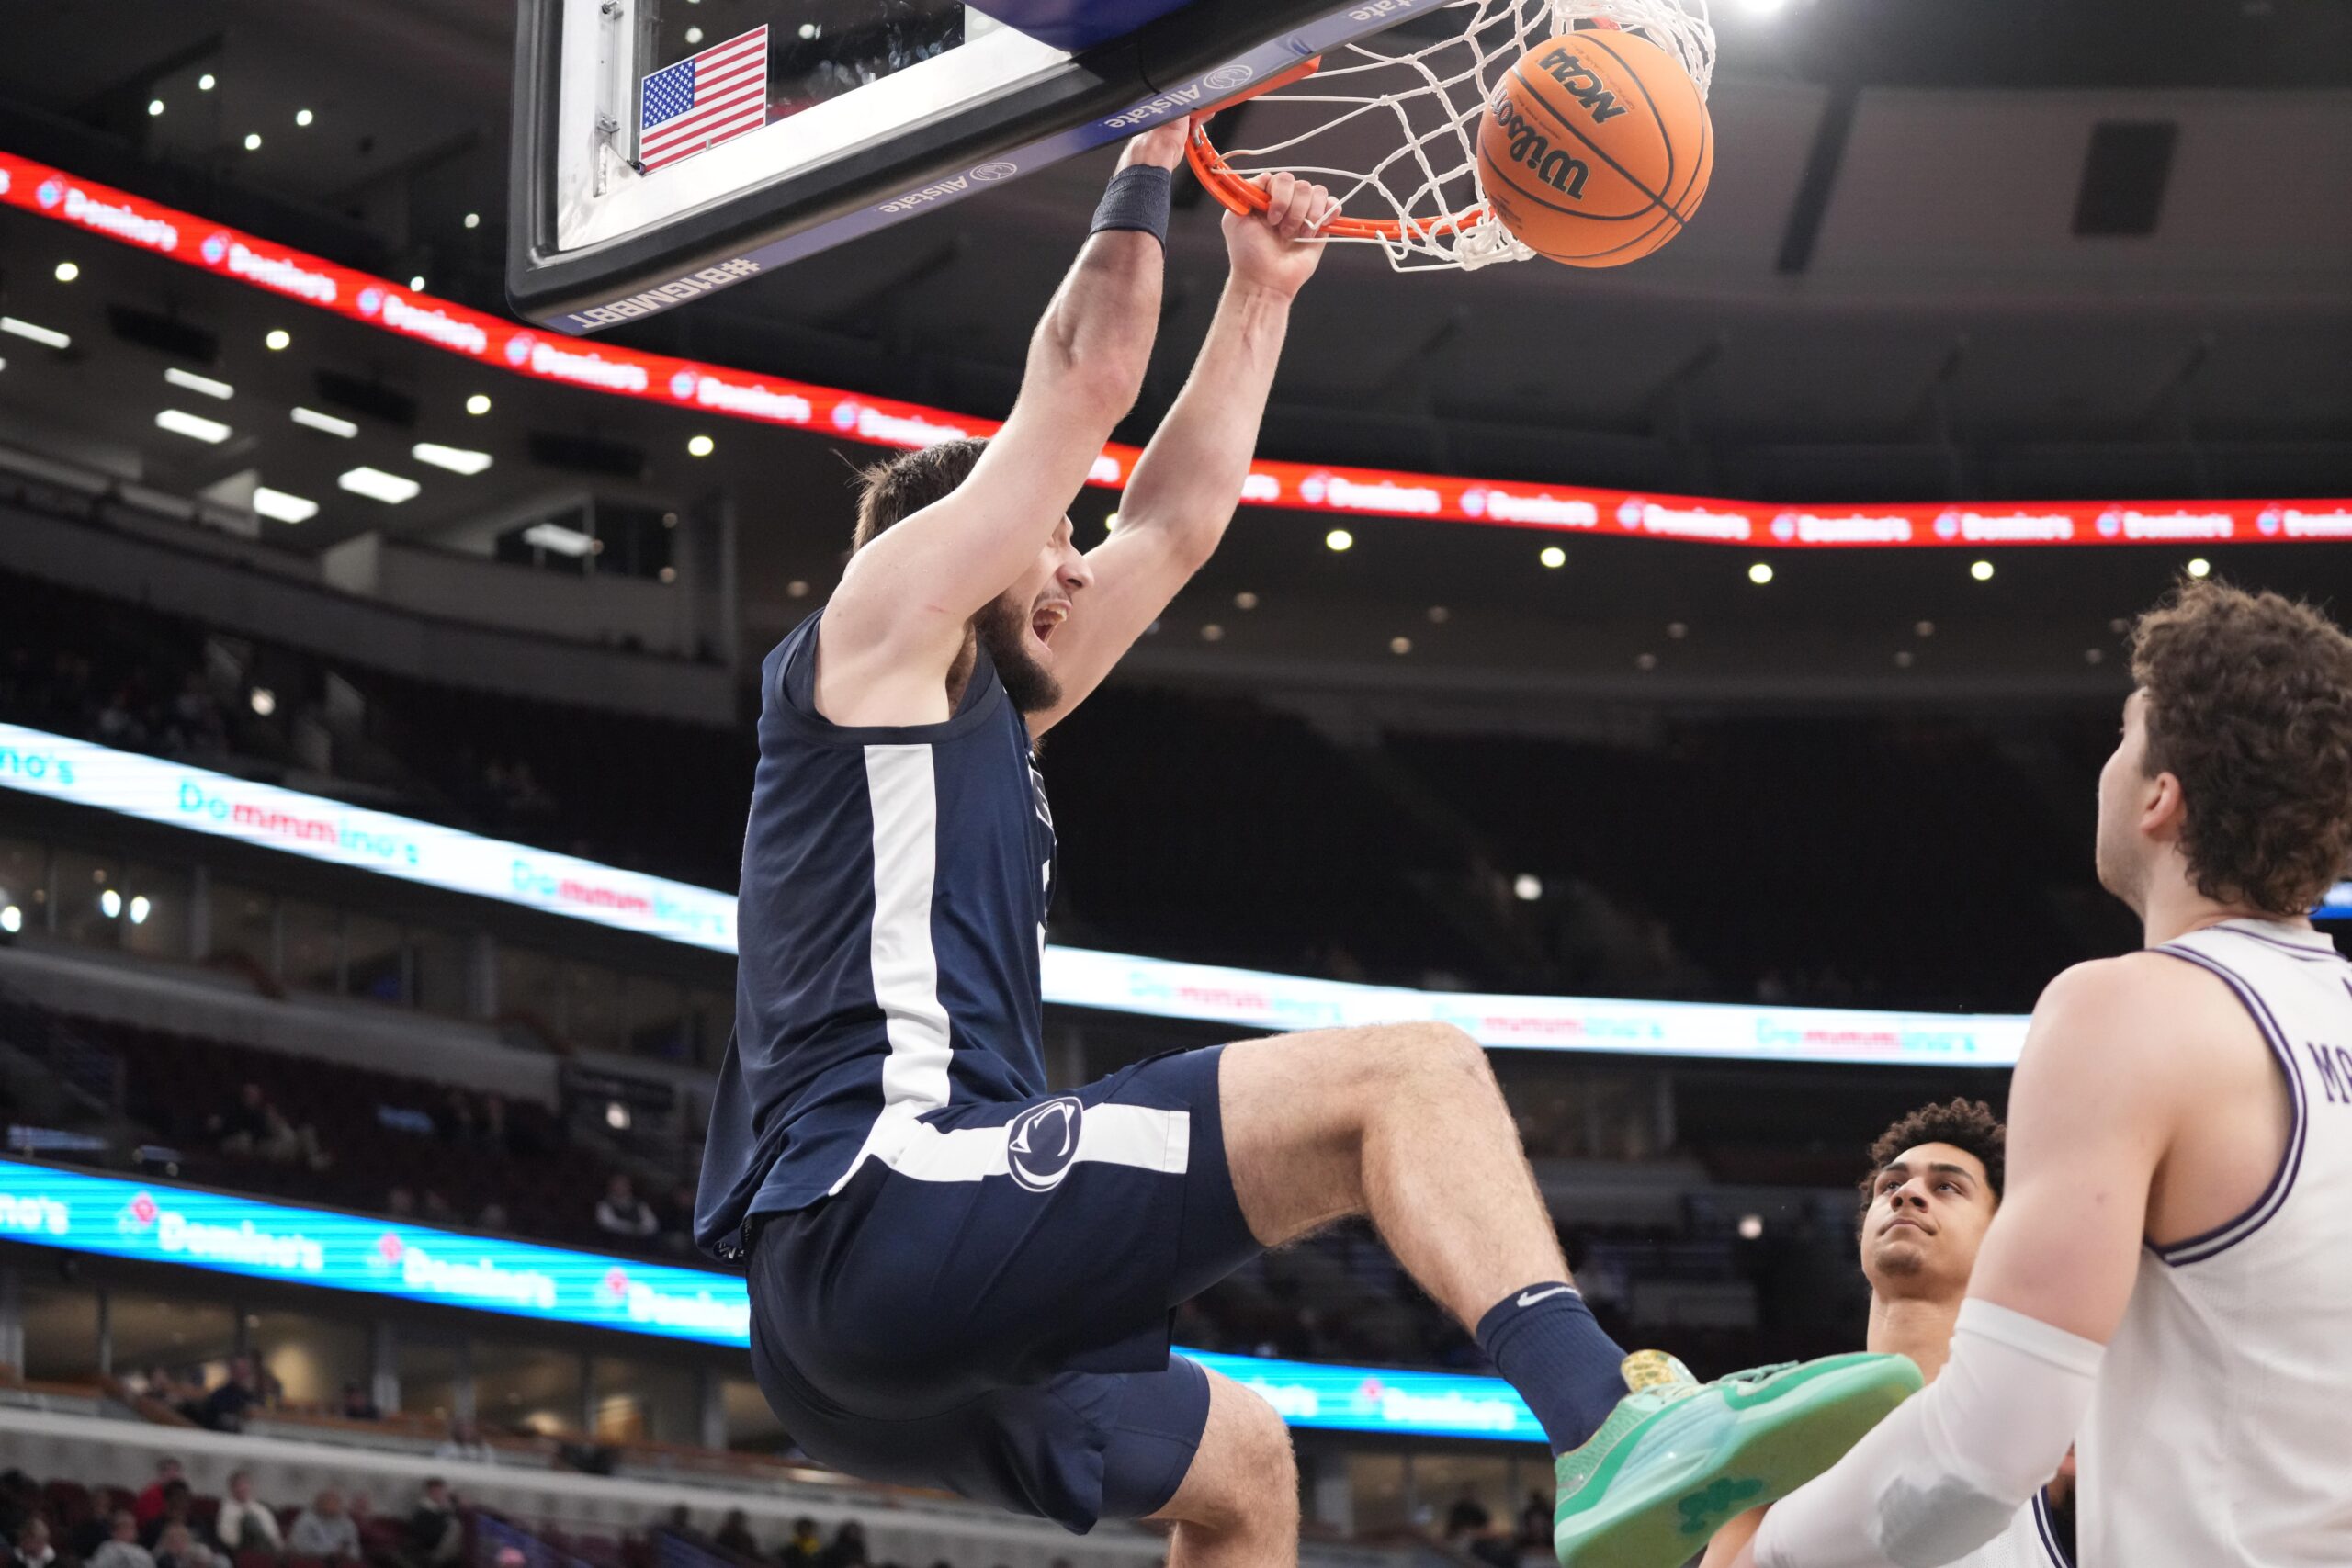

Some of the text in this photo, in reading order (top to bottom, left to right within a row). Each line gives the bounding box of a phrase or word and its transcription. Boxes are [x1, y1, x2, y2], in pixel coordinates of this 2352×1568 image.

[1348, 0, 1416, 21] tate
[1103, 84, 1202, 130] Allstate
[1535, 47, 1630, 125] NCAA
[878, 175, 968, 213] Allstate
[567, 258, 761, 329] #B1GMBBT
